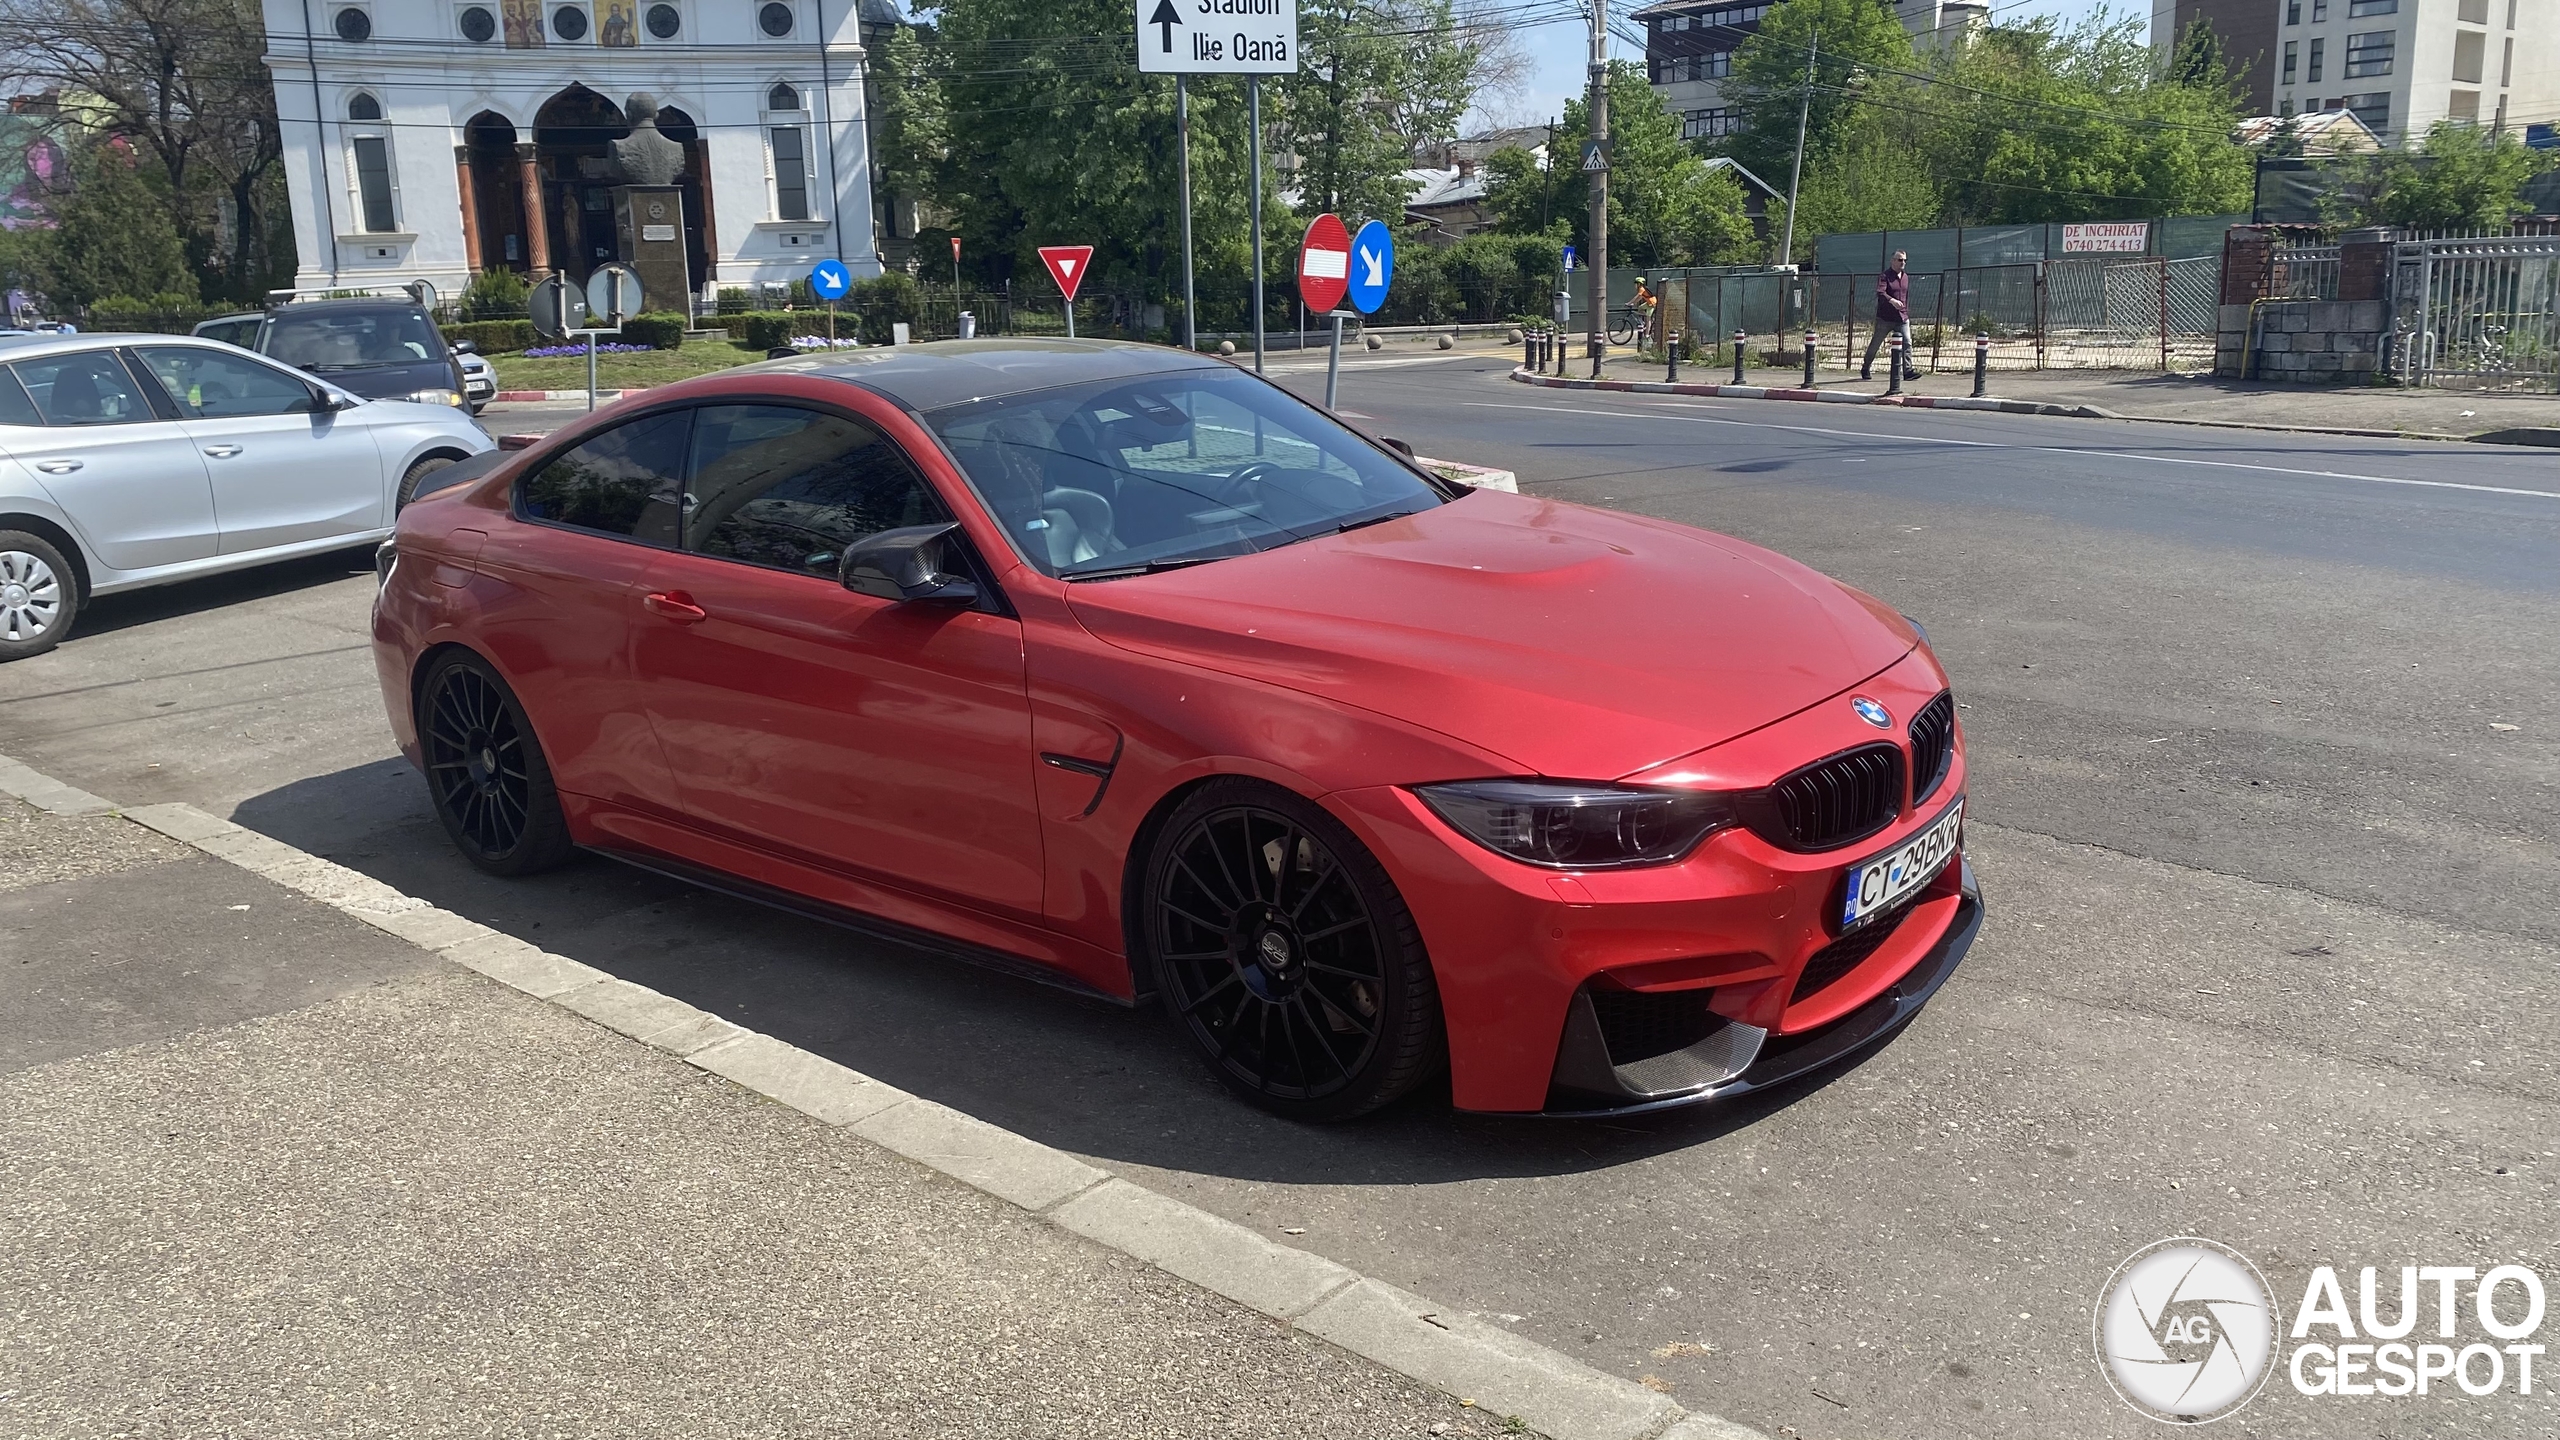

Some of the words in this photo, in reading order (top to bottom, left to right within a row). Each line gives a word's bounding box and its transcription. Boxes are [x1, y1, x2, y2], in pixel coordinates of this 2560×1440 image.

[1193, 32, 1223, 61] Ilie
[1233, 32, 1286, 61] Oană
[2065, 226, 2080, 237] DE
[2085, 225, 2146, 237] INCHIRIAT
[2066, 240, 2093, 251] 0740
[2096, 240, 2116, 251] 274
[2119, 239, 2141, 252] 413
[1844, 898, 1857, 918] RO
[1861, 856, 1896, 908] CT
[1898, 807, 1961, 889] 29BKR
